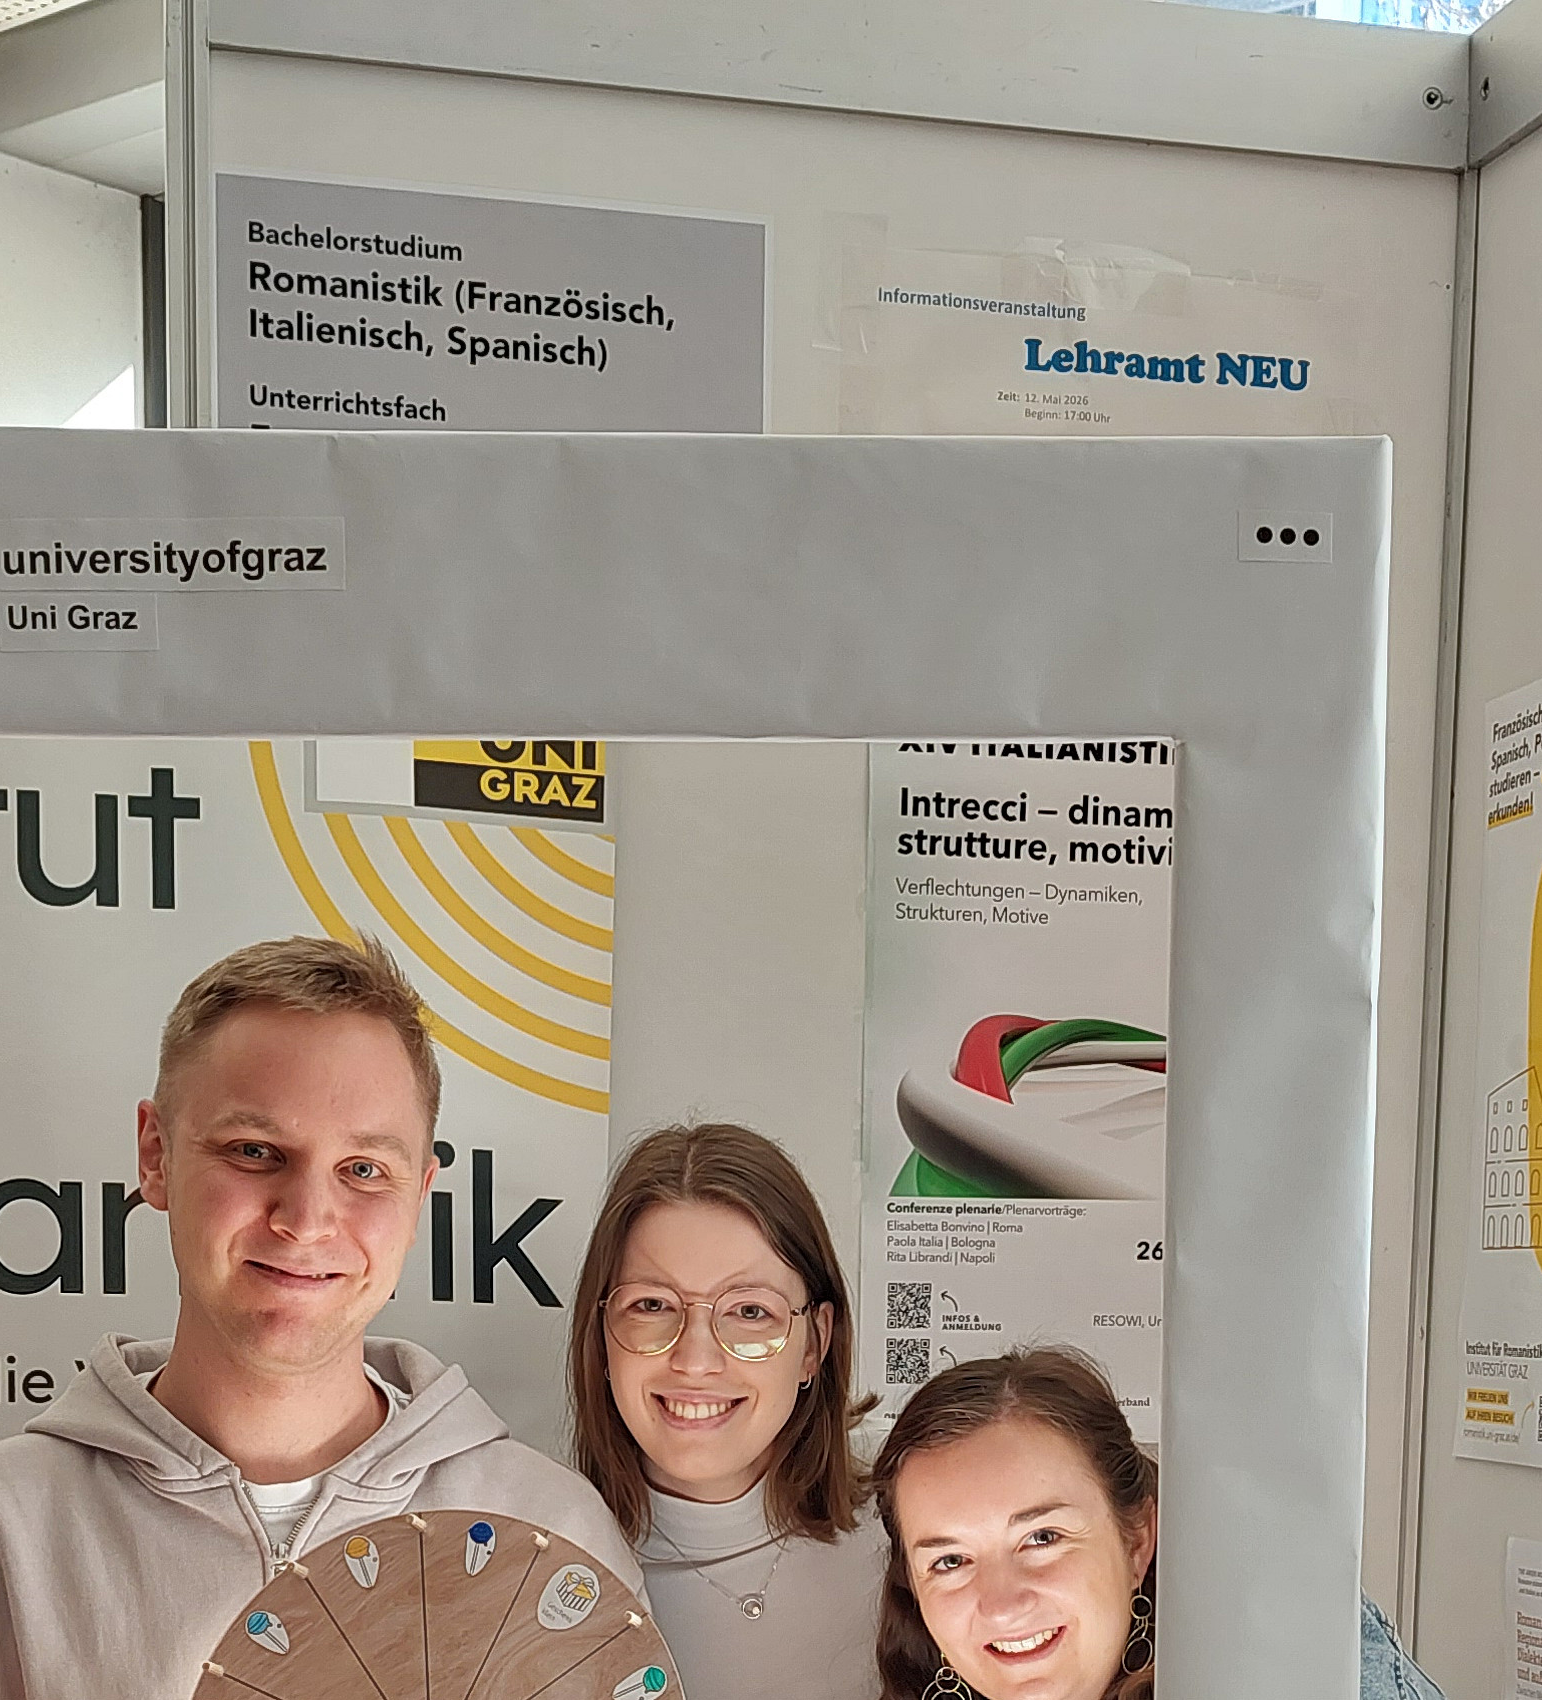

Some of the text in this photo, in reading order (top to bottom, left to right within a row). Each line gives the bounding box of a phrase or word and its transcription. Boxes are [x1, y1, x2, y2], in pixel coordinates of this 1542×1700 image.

[247, 221, 463, 261] Bachelorstudium
[248, 260, 676, 331] Romanistik (Französisch,
[878, 287, 1087, 321] Informationsveranstaltung
[249, 309, 608, 372] Italienisch, Spanisch)
[1025, 339, 1310, 391] Lehramt NEU
[249, 384, 446, 422] Unterrichtsfach
[998, 391, 1019, 402] Zeit:
[1025, 393, 1039, 403] 12.
[1043, 395, 1061, 404] Mai
[1025, 408, 1110, 423] Beginn: 17:00 Uhr
[3, 541, 327, 581] universityofgraz
[7, 605, 138, 631] Uni Graz
[971, 741, 1175, 765] ITALIANISTI
[1491, 737, 1531, 774] Spanisch,
[480, 769, 597, 808] GRAZ
[1489, 770, 1531, 797] studieren
[899, 787, 1027, 822] Intrecci
[1488, 791, 1533, 825] erkunden!
[897, 829, 1057, 865] strutture,
[896, 877, 1143, 906] Verflechtungen Dynamiken,
[896, 903, 1049, 924] Strukturen, Motive
[887, 1203, 953, 1214] Conferenze
[887, 1221, 1023, 1232] Elisabetta Bonvino Roma
[887, 1236, 995, 1248] Paola Italia Bologna
[1137, 1242, 1163, 1261] 26
[887, 1252, 995, 1265] Rita Librandi Napoli
[941, 1323, 1001, 1331] ANMELDUNG
[1093, 1315, 1145, 1328] RESOWI,
